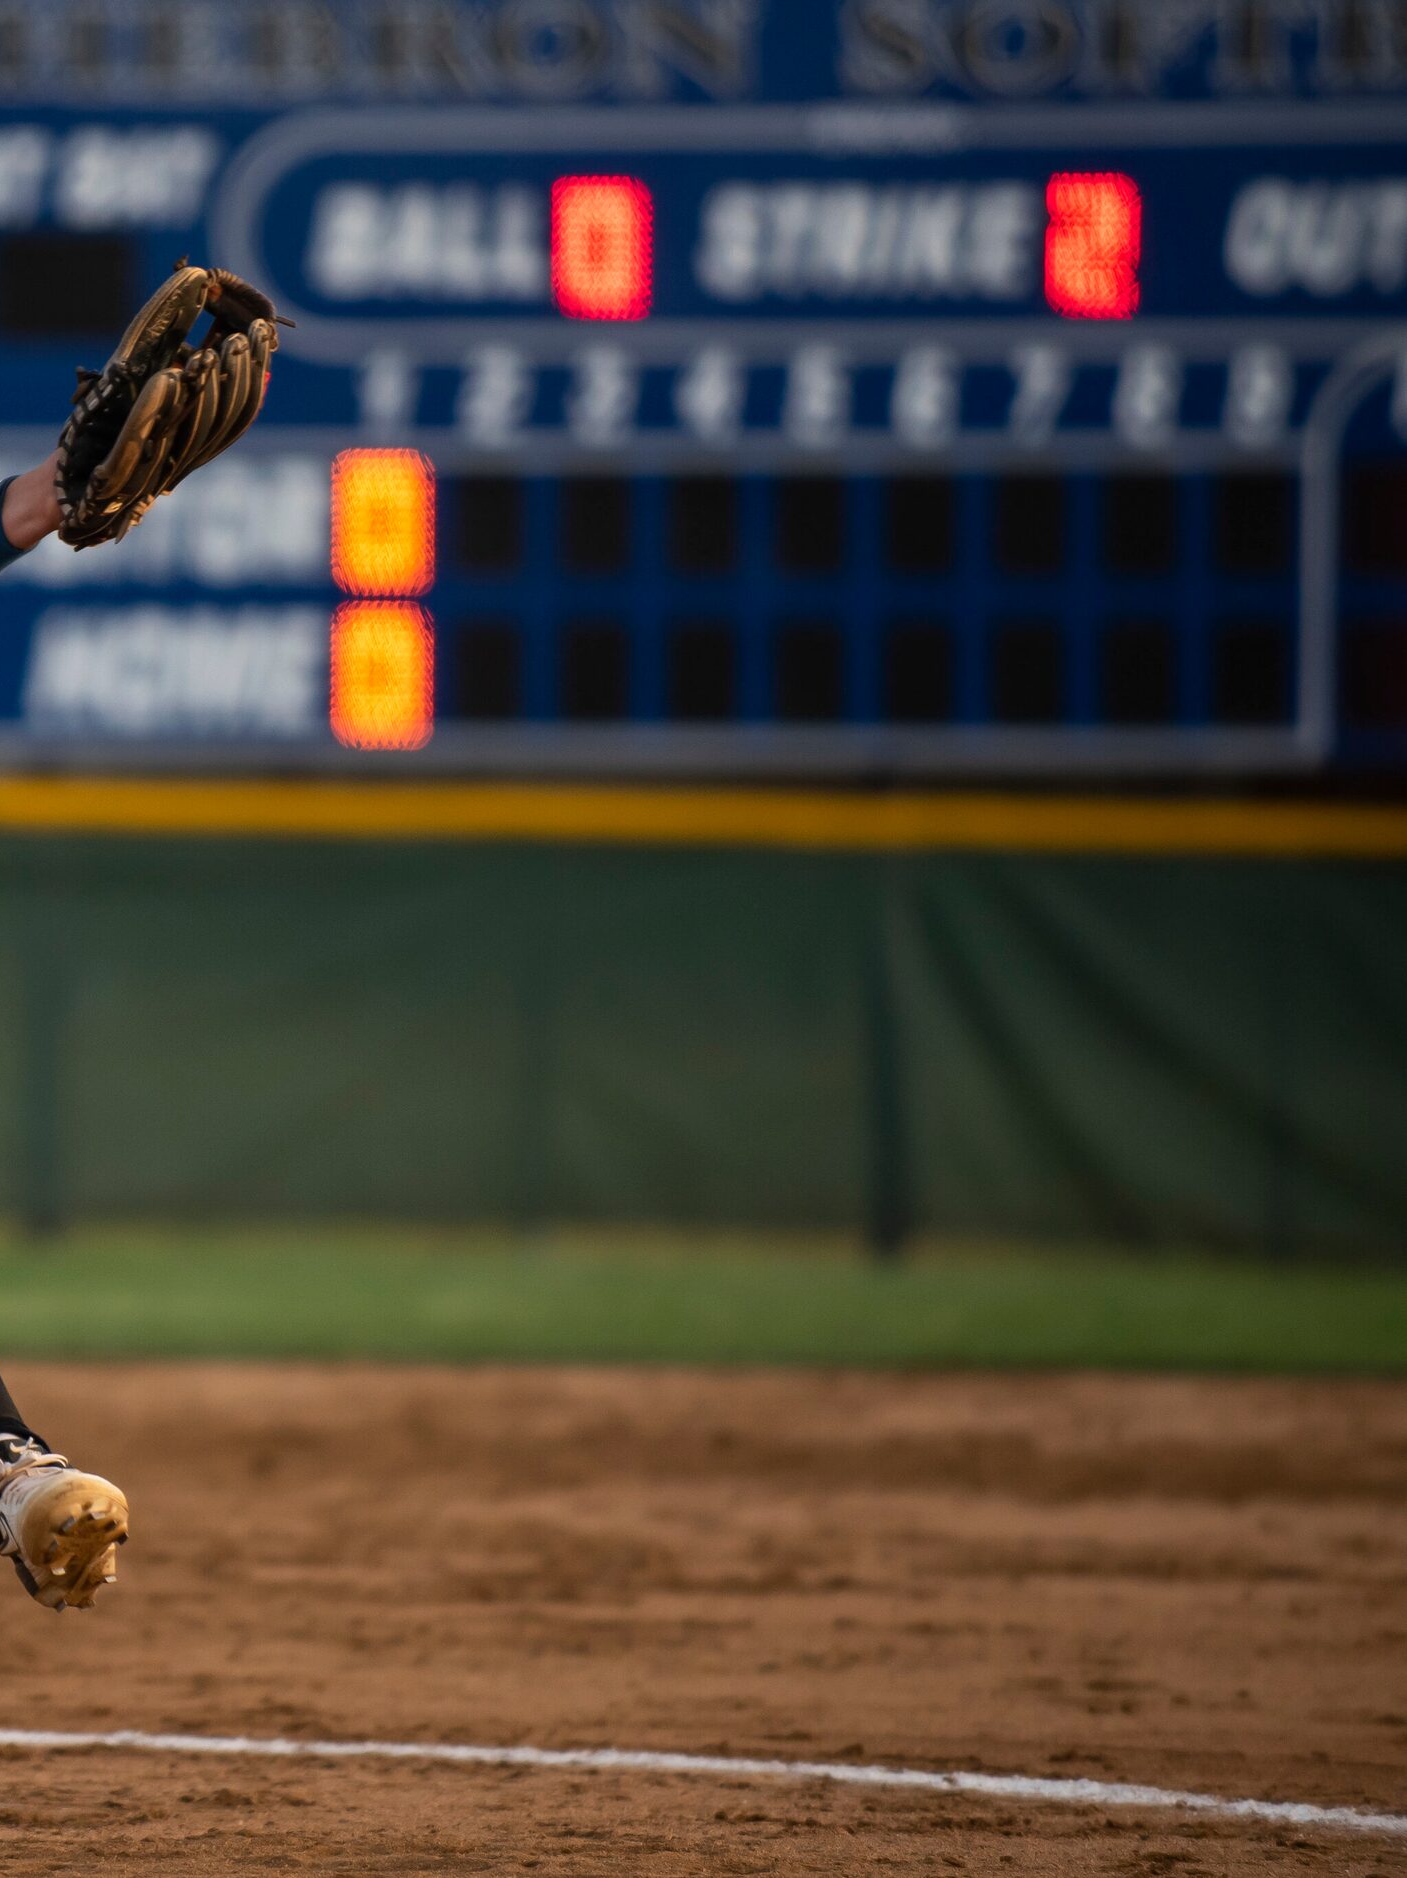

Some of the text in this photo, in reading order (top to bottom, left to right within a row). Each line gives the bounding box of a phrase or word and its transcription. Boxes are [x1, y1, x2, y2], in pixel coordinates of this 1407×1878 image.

[309, 184, 550, 294] BALL
[550, 174, 654, 321] 0
[699, 182, 1039, 296] STRIKE
[1045, 172, 1142, 320] 2
[331, 447, 436, 597] 0
[330, 600, 435, 752] 0
